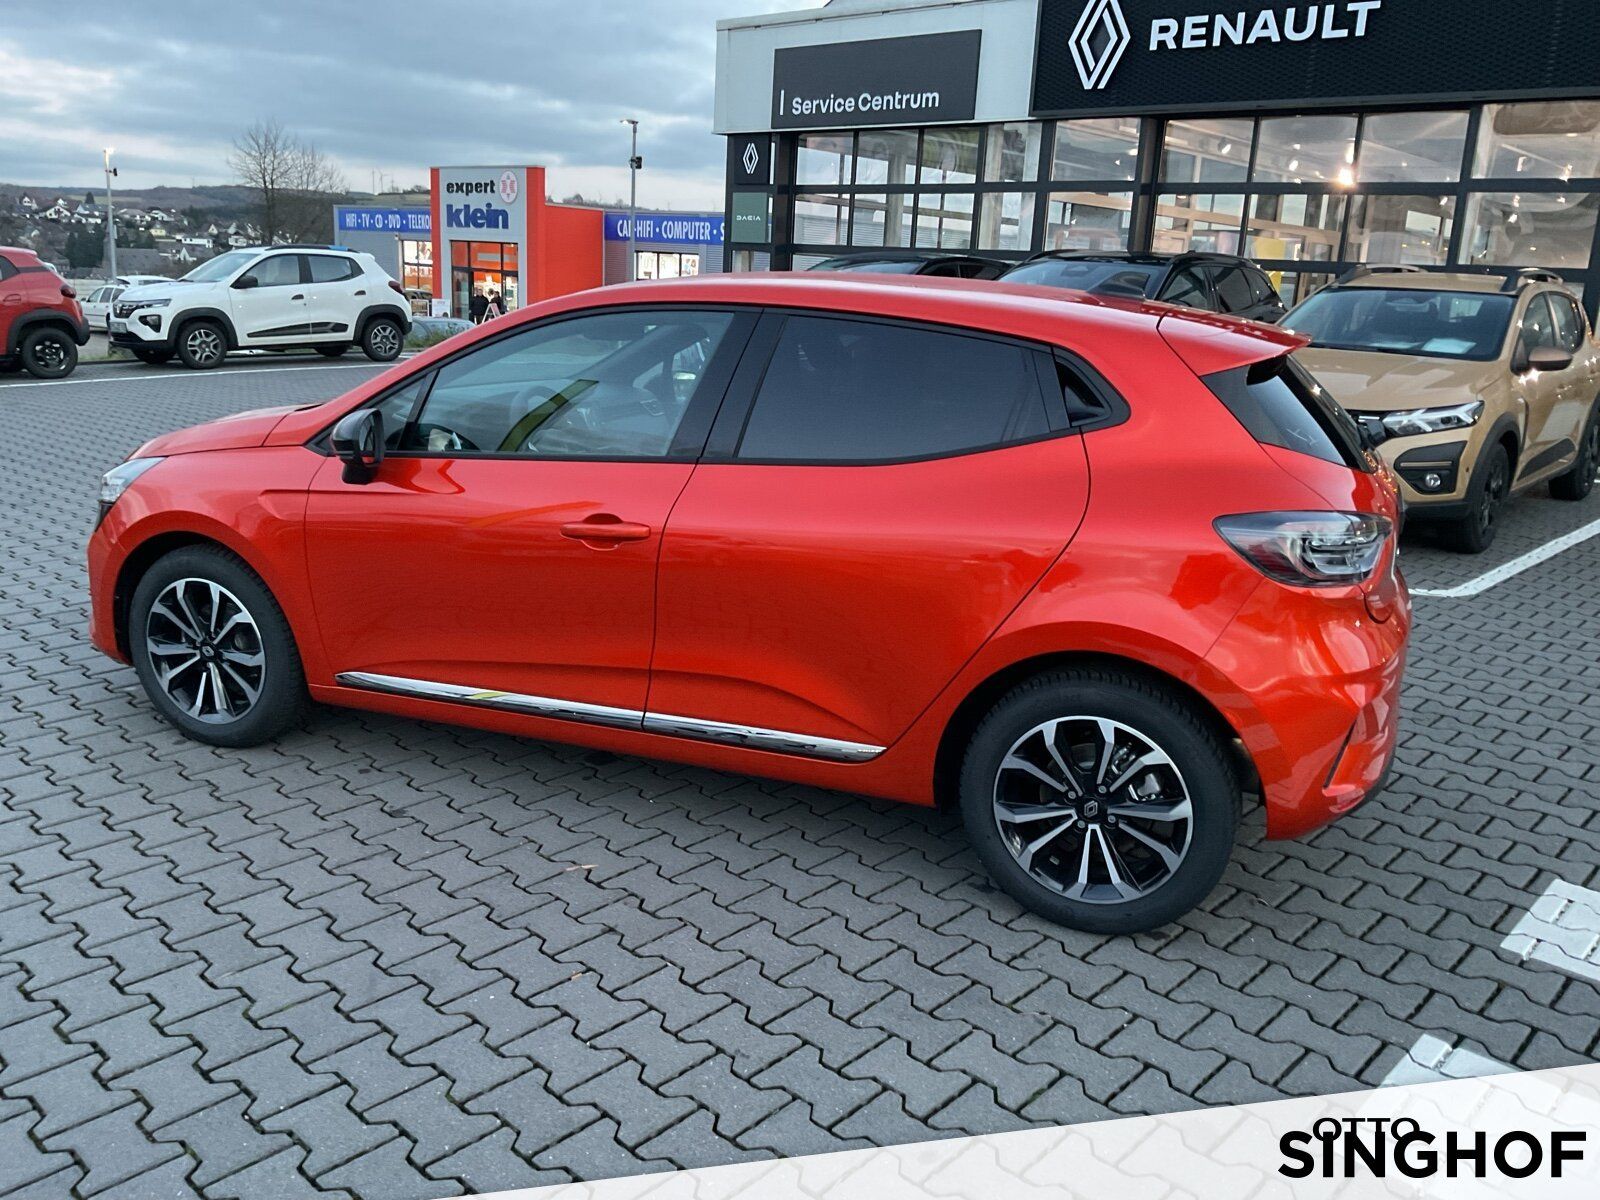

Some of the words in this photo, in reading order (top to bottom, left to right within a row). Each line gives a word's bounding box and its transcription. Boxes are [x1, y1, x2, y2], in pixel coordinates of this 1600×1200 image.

[1149, 0, 1381, 51] RENAULT
[791, 94, 855, 115] Service
[858, 91, 940, 112] Centrum
[446, 180, 496, 196] expert
[361, 213, 370, 228] TV
[374, 214, 383, 228] CD
[388, 214, 401, 229] DVD
[407, 214, 432, 230] TELEKO
[446, 202, 509, 229] klein
[661, 221, 711, 241] COMPUTER
